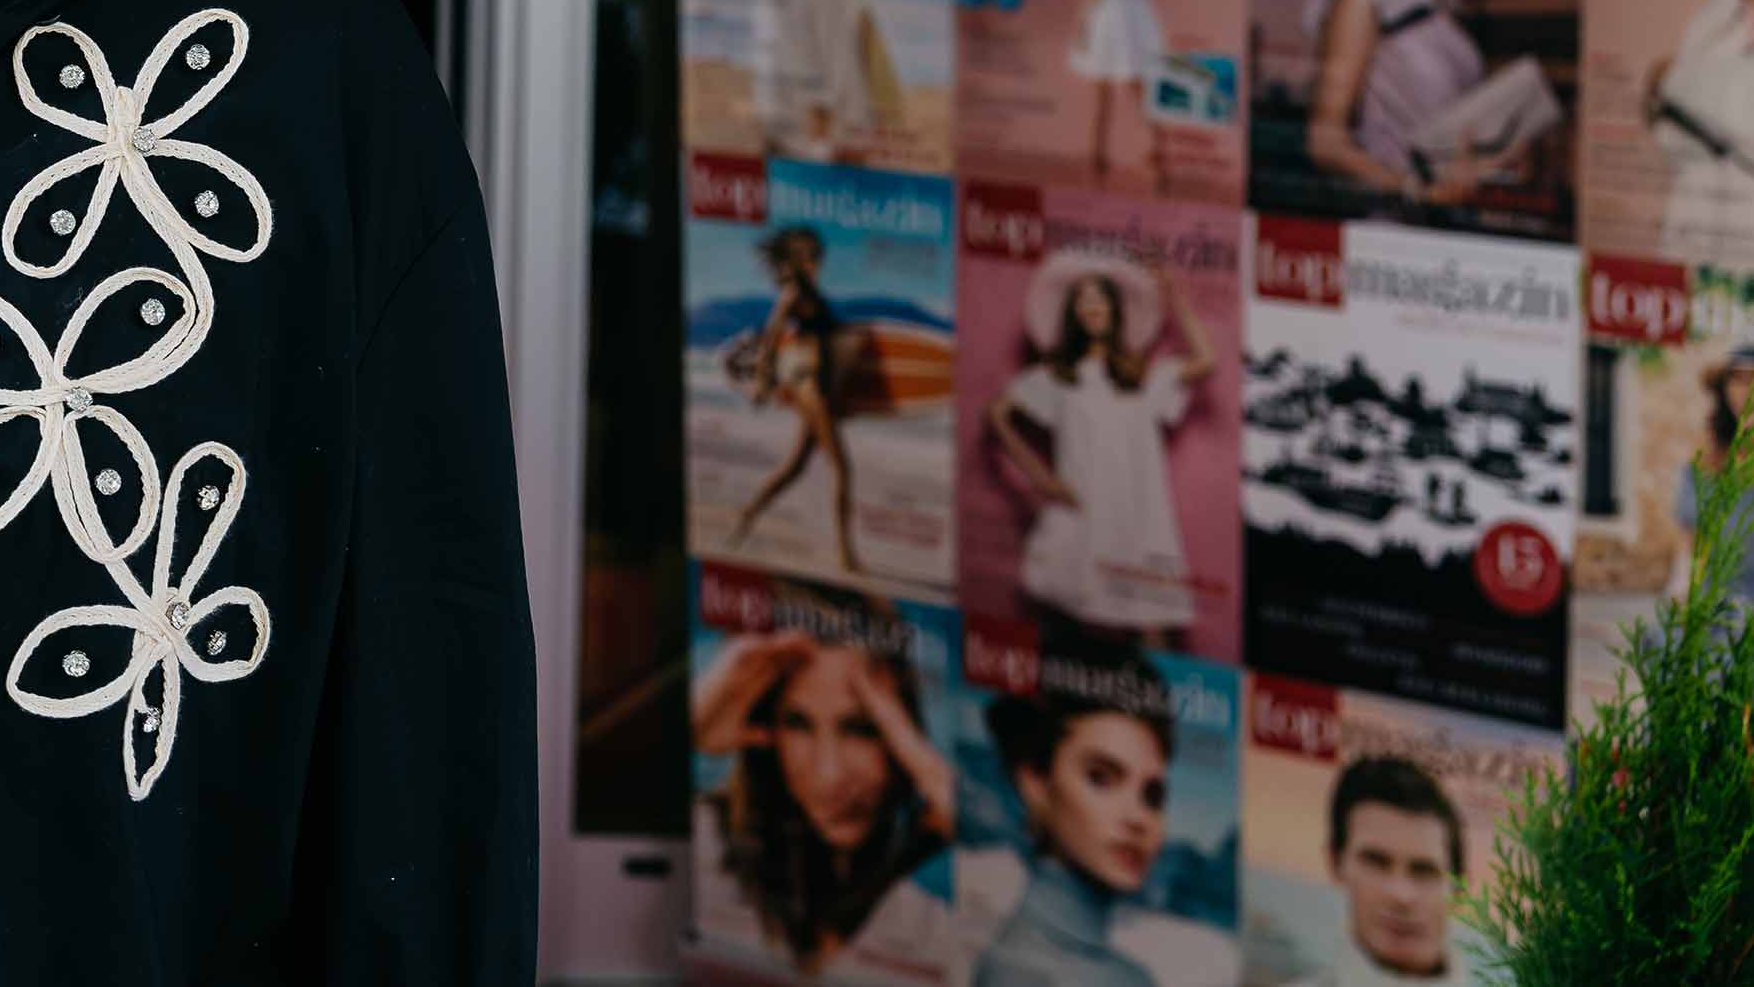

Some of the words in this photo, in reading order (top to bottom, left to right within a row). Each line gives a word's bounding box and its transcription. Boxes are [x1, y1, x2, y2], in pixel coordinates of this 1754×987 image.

[1257, 242, 1343, 300] top
[1348, 258, 1570, 324] magazin
[1591, 271, 1684, 338] top
[1252, 690, 1341, 750] top
